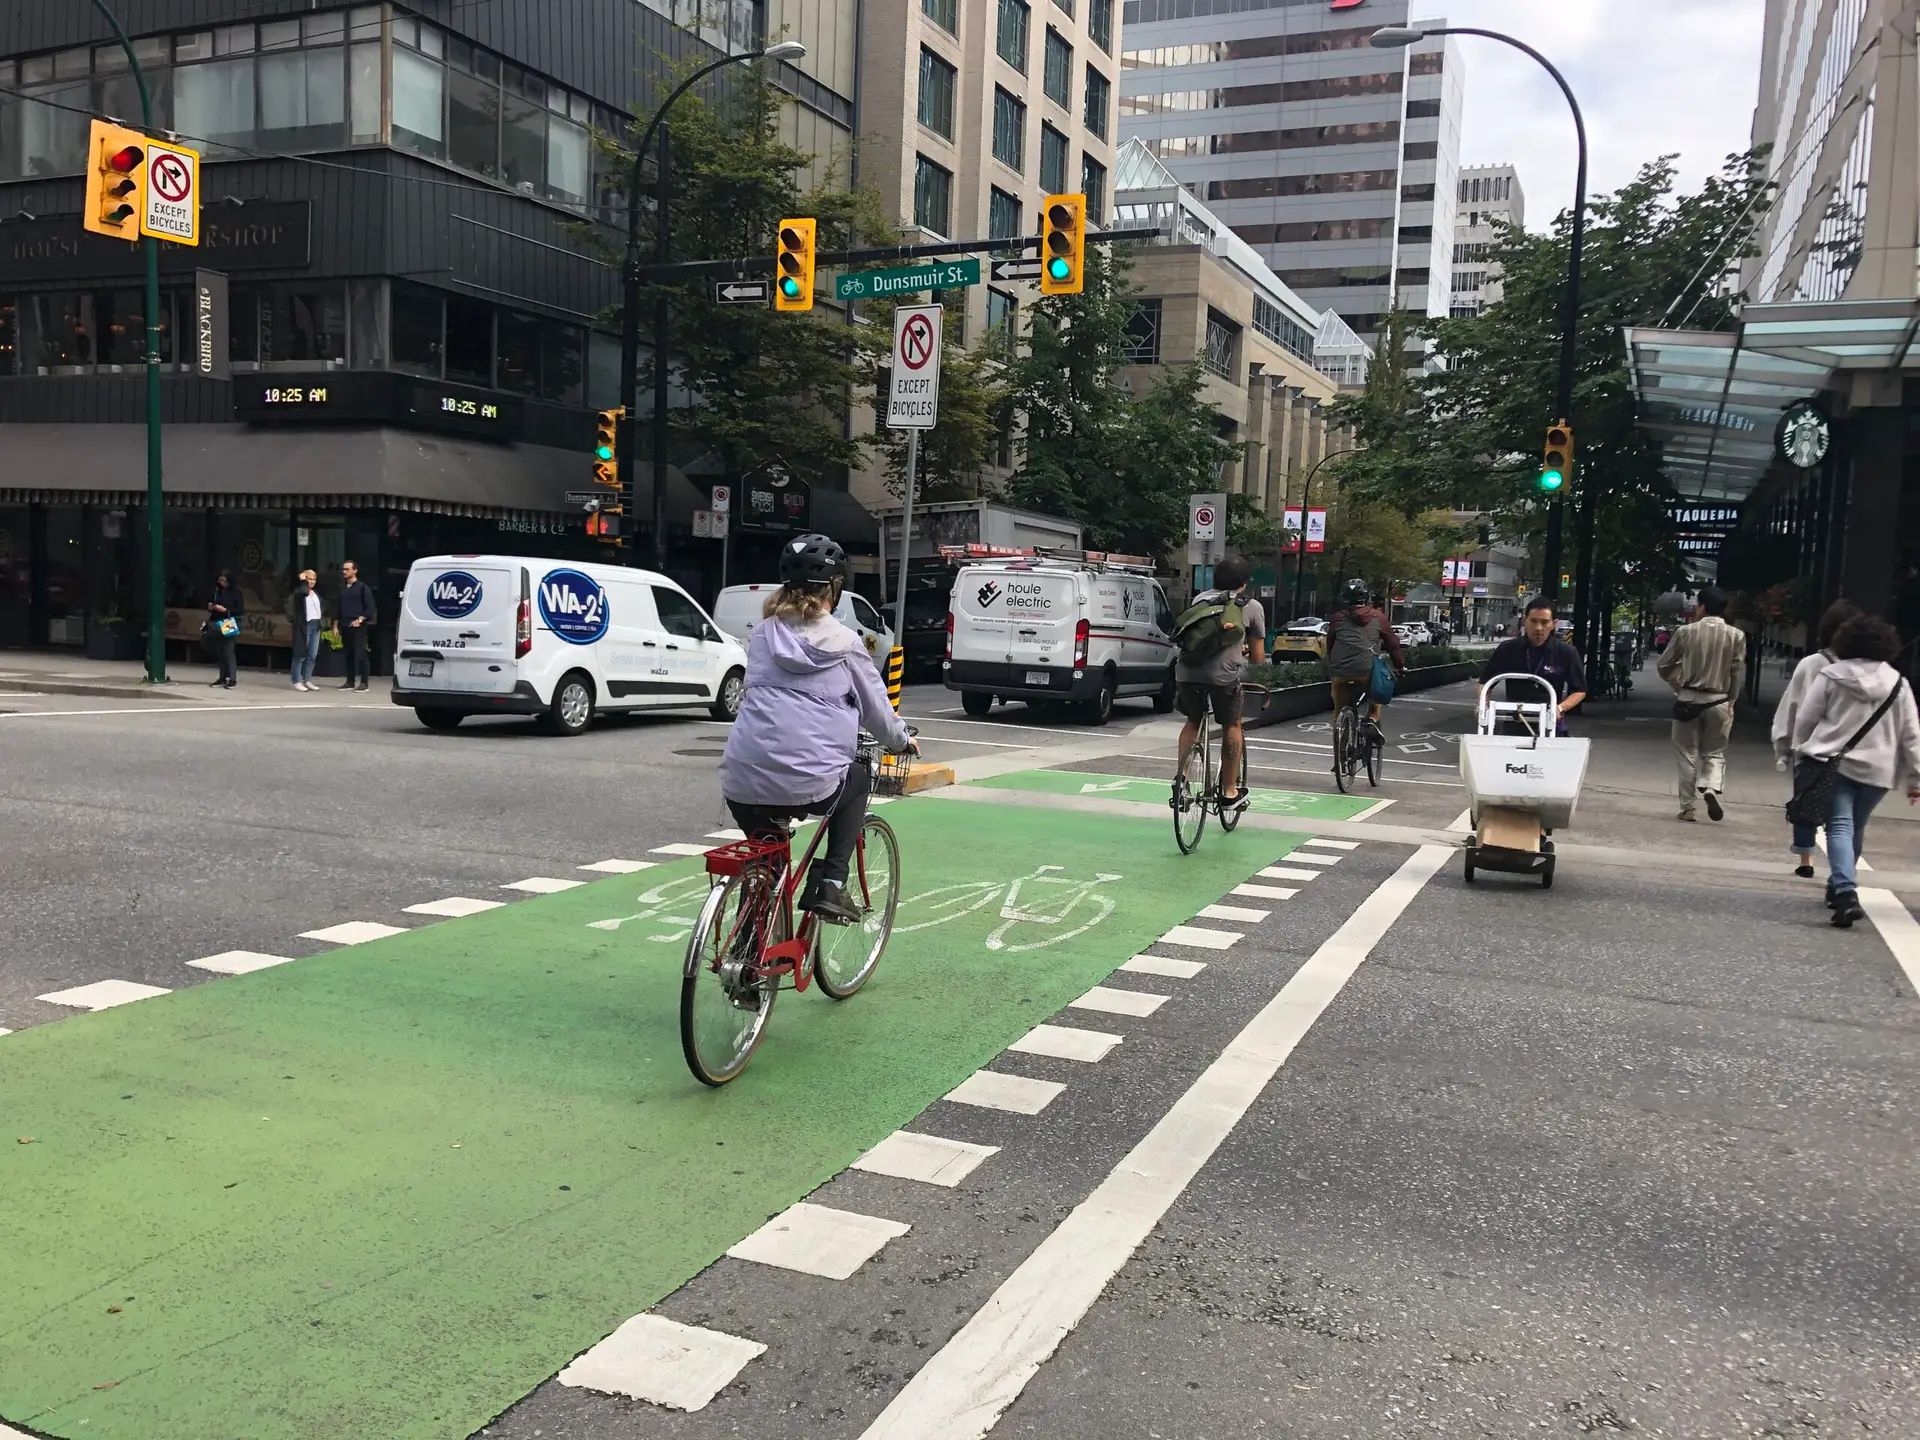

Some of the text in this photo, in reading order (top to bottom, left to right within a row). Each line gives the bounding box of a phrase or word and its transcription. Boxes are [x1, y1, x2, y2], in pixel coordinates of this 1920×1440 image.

[154, 203, 186, 219] EXCEPT
[150, 214, 191, 233] BICYCLES
[873, 267, 969, 292] Dunsmuir St.
[200, 295, 211, 373] BLACKBIRD
[898, 379, 931, 394] EXCEPT
[265, 388, 326, 403] 10:25 AM
[441, 397, 497, 418] 10:25 AM
[892, 401, 933, 417] BICYCLES
[498, 520, 538, 533] BARBER
[540, 524, 547, 533] &
[432, 581, 483, 605] WA-2!
[1007, 582, 1042, 594] houle
[541, 582, 604, 624] WA-2!
[1006, 596, 1052, 608] electric
[432, 639, 466, 648] wa2.ca
